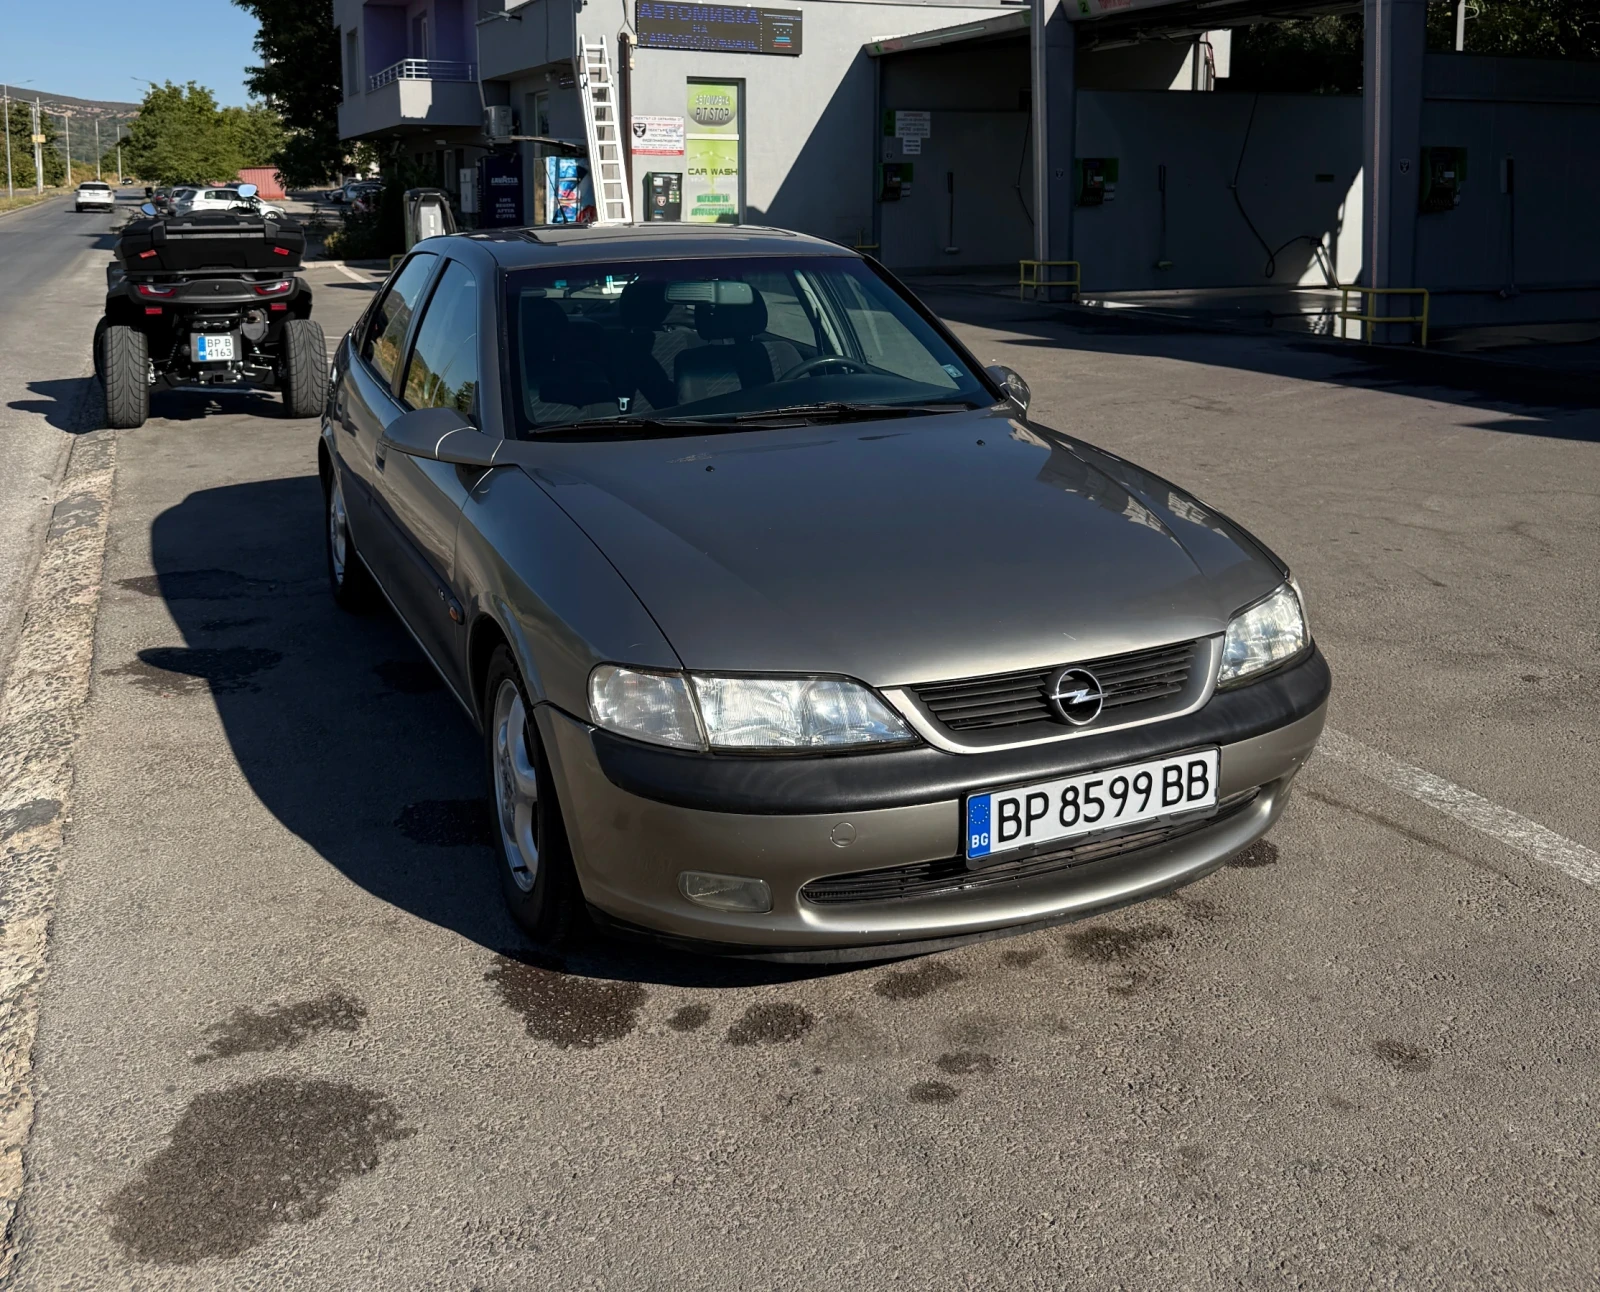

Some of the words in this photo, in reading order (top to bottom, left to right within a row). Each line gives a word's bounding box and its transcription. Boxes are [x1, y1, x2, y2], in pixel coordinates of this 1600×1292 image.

[639, 3, 759, 24] АВТОМИВКА
[1081, 2, 1089, 13] 2
[696, 107, 708, 120] PIT
[709, 107, 730, 121] STOP
[688, 168, 708, 176] CAR
[710, 168, 738, 176] WASH
[207, 338, 221, 348] BP
[224, 338, 232, 347] B
[207, 348, 232, 358] 4163
[998, 791, 1050, 843] BP
[1059, 771, 1153, 828] 8599
[1161, 759, 1210, 808] BB
[971, 832, 989, 849] BG
